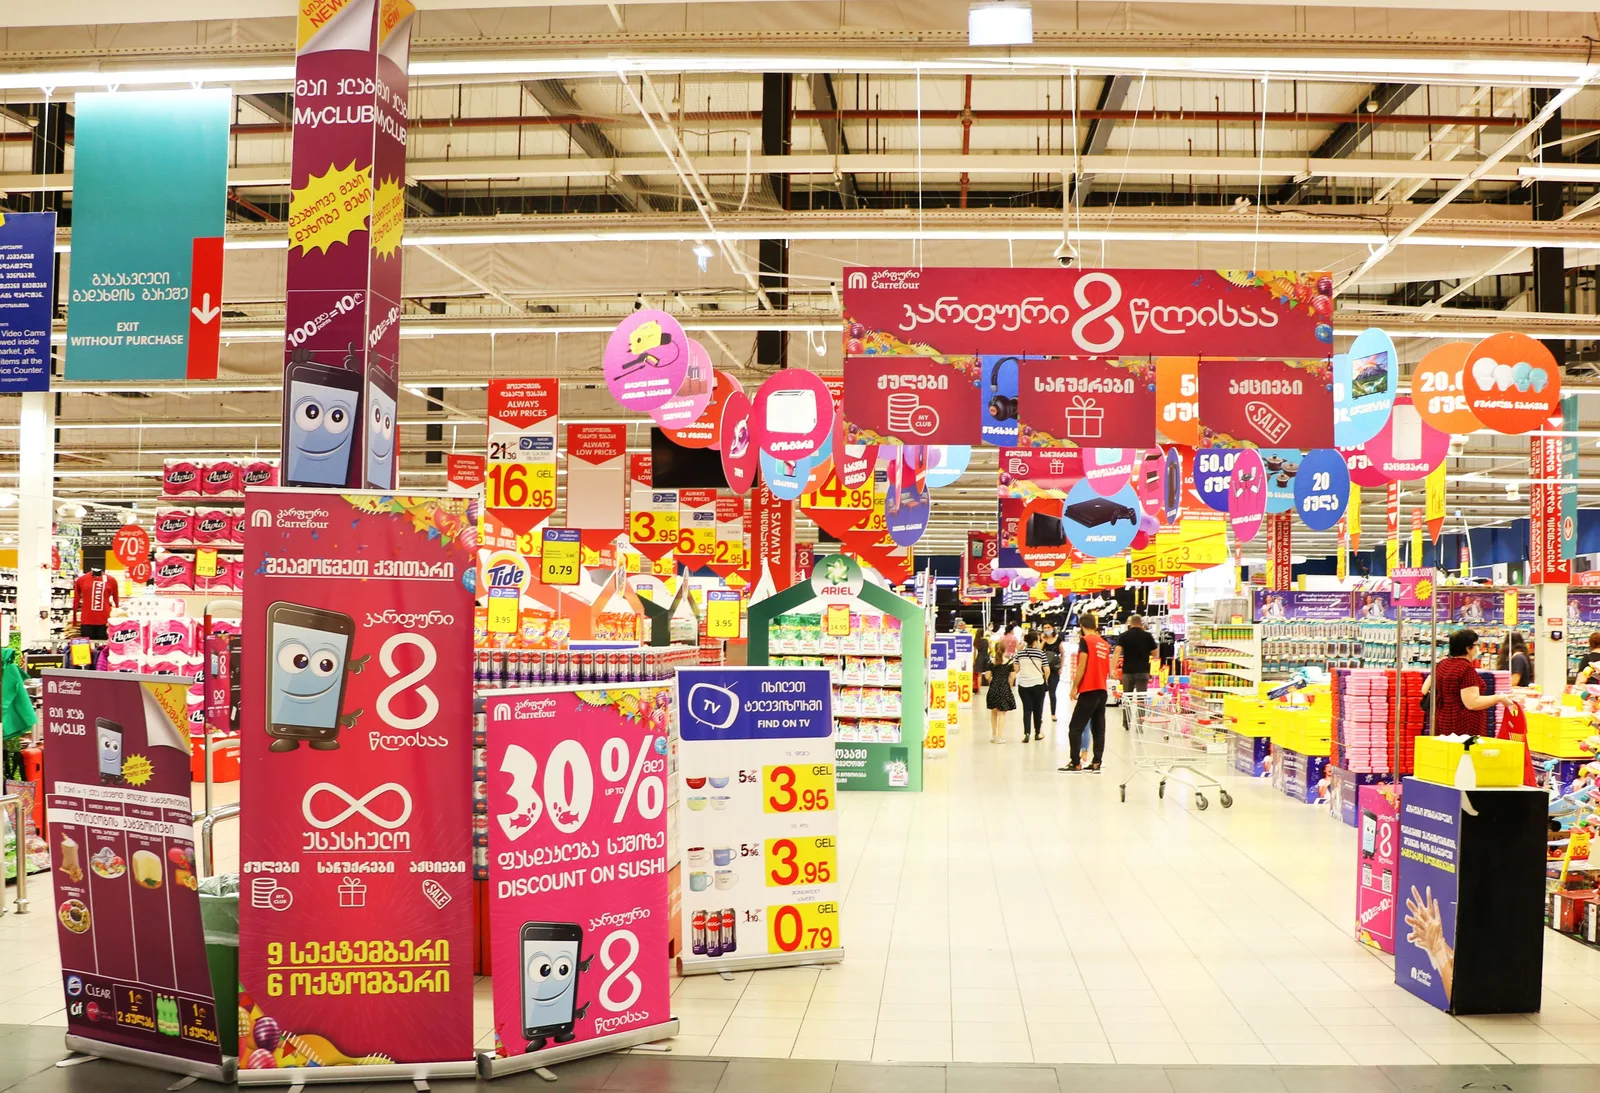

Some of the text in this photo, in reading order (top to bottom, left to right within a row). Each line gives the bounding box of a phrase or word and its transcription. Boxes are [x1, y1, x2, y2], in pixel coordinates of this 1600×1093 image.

[296, 77, 375, 96] მაი ქლაბ
[294, 105, 374, 129] MyCLUB
[375, 105, 407, 146] MyCLUB
[289, 174, 364, 228] დააგროვე მეტი
[295, 188, 371, 242] დაზოგე მეტი
[92, 272, 170, 286] გასასვლელი
[871, 270, 920, 281] კარფური
[871, 280, 920, 290] Carrefour
[72, 287, 189, 302] გადახდის გარეშე
[898, 296, 1070, 332] კარფური
[1071, 272, 1125, 354] 8
[1129, 298, 1279, 335] წლისაა
[117, 322, 139, 332] EXIT
[71, 335, 184, 346] WITHOUT PURCHASE
[13, 366, 44, 374] Counter.
[877, 374, 948, 390] ქულები
[1034, 376, 1135, 393] საჩუქრები
[1228, 379, 1303, 395] აქციები
[507, 400, 539, 408] ALWAYS
[520, 409, 548, 417] PRICES
[1252, 406, 1285, 440] SALE
[167, 472, 195, 482] Papia
[206, 471, 233, 482] Papia
[244, 471, 270, 482] Papia
[537, 470, 554, 478] GEL
[1312, 472, 1330, 491] 20
[489, 464, 553, 508] 16.95
[1303, 494, 1339, 512] ქულა
[277, 508, 328, 520] კარფური
[160, 520, 187, 530] Papia
[200, 519, 226, 530] Papia
[277, 518, 328, 529] Carrefour
[633, 511, 678, 542] 3.95
[677, 528, 715, 554] 6.95
[771, 512, 781, 565] ALWAYS
[716, 540, 742, 564] 2.95
[159, 564, 186, 575] Papia
[266, 557, 454, 578] შეამოწმეთ ქვითარი
[548, 565, 573, 576] 0.79
[1132, 564, 1156, 576] 399
[488, 565, 524, 586] Tide
[95, 582, 103, 610] VISUAL
[821, 586, 854, 596] ARIEL
[363, 609, 454, 629] კარფური
[715, 619, 732, 627] 3.95
[112, 629, 139, 643] Papia
[376, 632, 440, 730] 8
[761, 681, 806, 693] იხილეთ
[50, 707, 63, 718] მაი
[514, 699, 556, 711] კარფური
[703, 699, 721, 714] TV
[744, 699, 823, 712] ტელევიზორში
[514, 709, 556, 720] Carrefour
[50, 722, 86, 736] MyCLUB
[758, 719, 810, 728] FIND ON TV
[369, 732, 448, 751] წლისაა
[643, 759, 664, 774] მდე
[812, 766, 832, 776] GEL
[496, 735, 665, 842] 30%
[605, 787, 625, 796] UP TO
[769, 765, 829, 813] 3.95
[303, 831, 411, 850] უსასრულო
[815, 838, 835, 848] GEL
[497, 831, 665, 870] ფასდაკლება სუშიზე
[1573, 845, 1587, 856] 105
[243, 861, 300, 873] ქულები
[317, 861, 395, 874] საჩუქრები
[409, 860, 466, 873] აქციები
[771, 838, 830, 886] 3.95
[498, 857, 665, 899] DISCOUNT ON SUSHI
[427, 884, 447, 907] SALE
[817, 904, 837, 914] GEL
[588, 906, 650, 932] კარფური
[774, 905, 833, 952] 0.79
[267, 939, 449, 965] 9 სექტემბერი
[599, 929, 642, 1012] 8
[267, 970, 450, 997] 6 ოქტომბერი
[118, 1011, 123, 1022] 2
[594, 1011, 649, 1034] წლისაა
